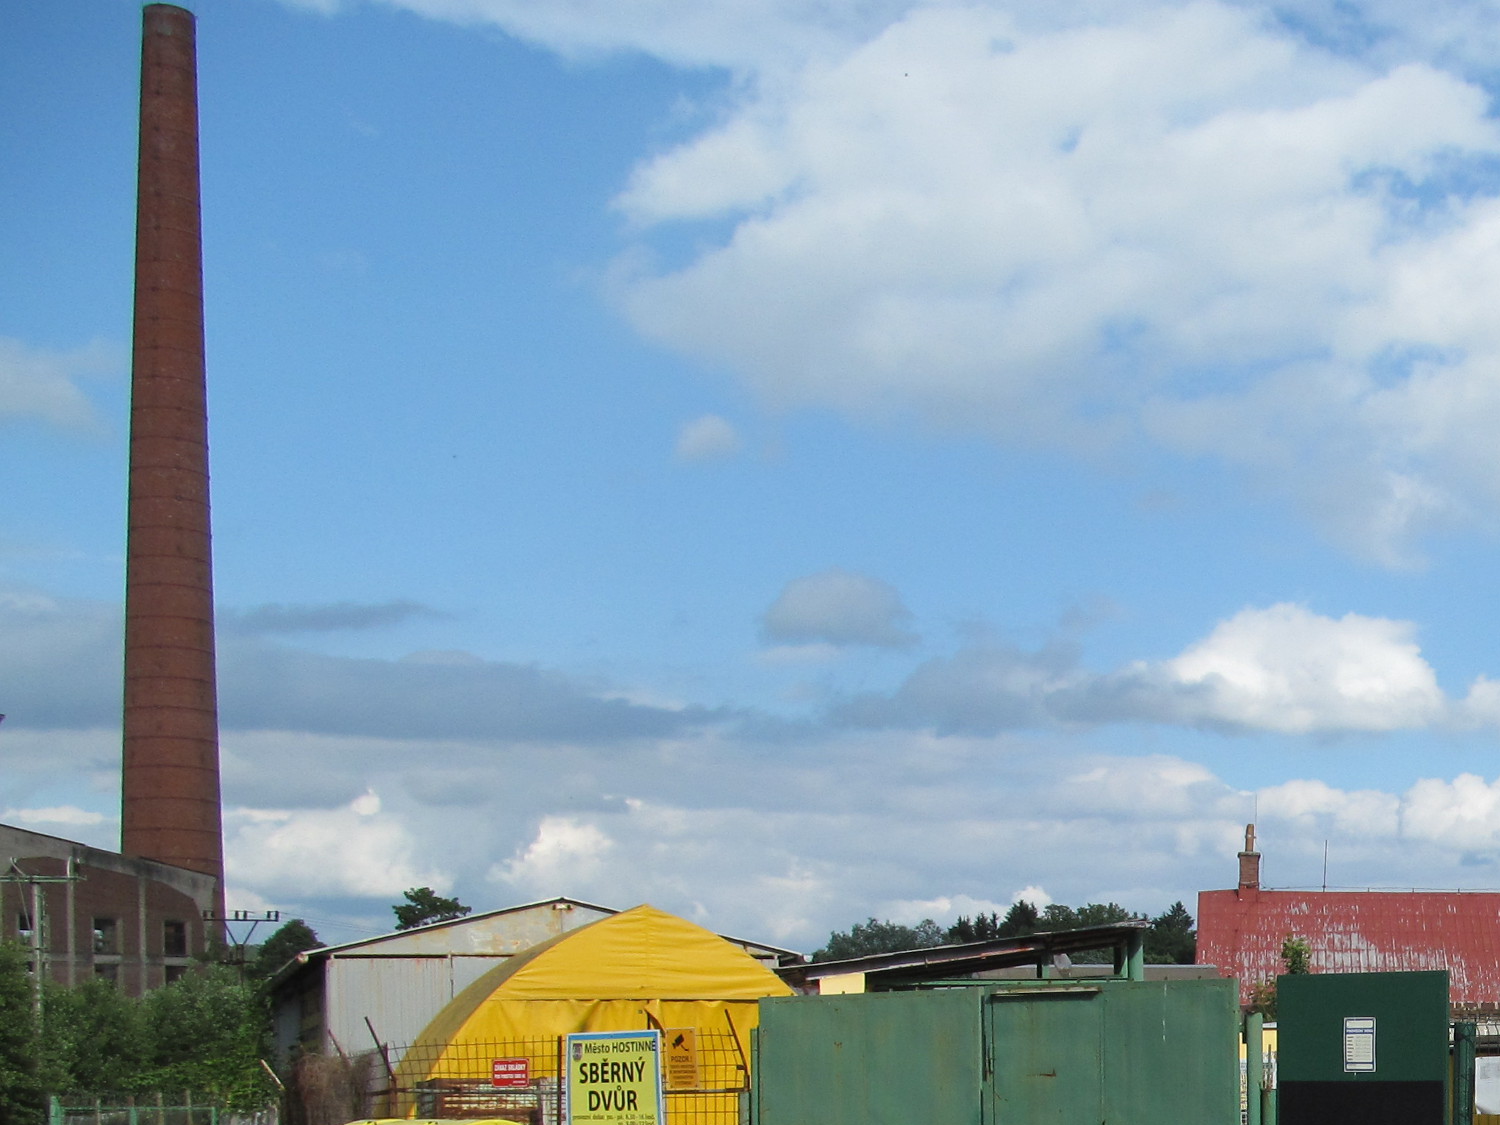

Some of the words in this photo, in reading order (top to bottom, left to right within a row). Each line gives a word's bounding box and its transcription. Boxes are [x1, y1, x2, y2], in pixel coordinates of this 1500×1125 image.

[584, 1043, 611, 1054] Město
[612, 1040, 656, 1053] HOSTINNÉ
[579, 1056, 646, 1084] SBĚRNÝ
[588, 1086, 638, 1112] DVŮR
